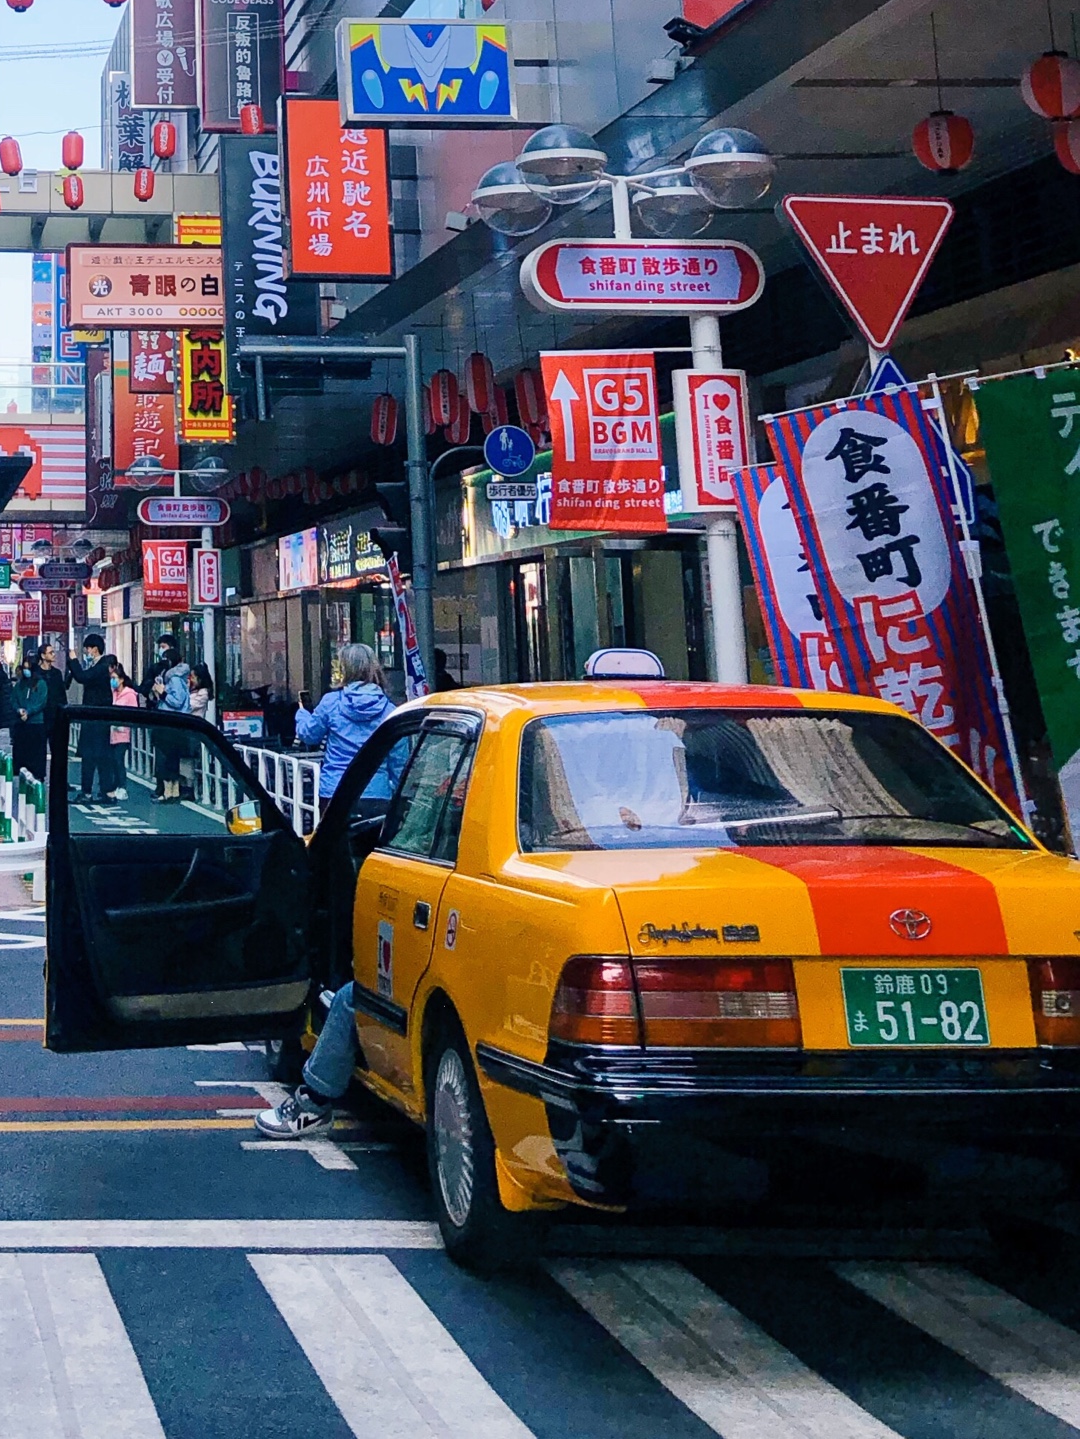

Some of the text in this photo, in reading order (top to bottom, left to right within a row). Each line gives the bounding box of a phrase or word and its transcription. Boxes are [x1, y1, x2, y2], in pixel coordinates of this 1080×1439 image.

[306, 156, 333, 257] 広州市場
[248, 150, 288, 326] BURNING
[826, 220, 921, 257] 止まれ
[579, 255, 719, 277] 食番町 散歩通り
[92, 279, 108, 295] 光
[588, 279, 711, 295] shifan ding street
[129, 308, 163, 316] 3000
[594, 379, 644, 412] G5
[593, 421, 653, 444] BGM
[488, 483, 537, 497] 歩行者優先
[557, 478, 660, 494] 食番町 散歩通り
[557, 497, 660, 510] shifan ding street
[161, 551, 182, 563] G4
[160, 567, 185, 577] BGM
[873, 973, 949, 996] 鈴鹿 09
[853, 1000, 984, 1043] ま 51-82
